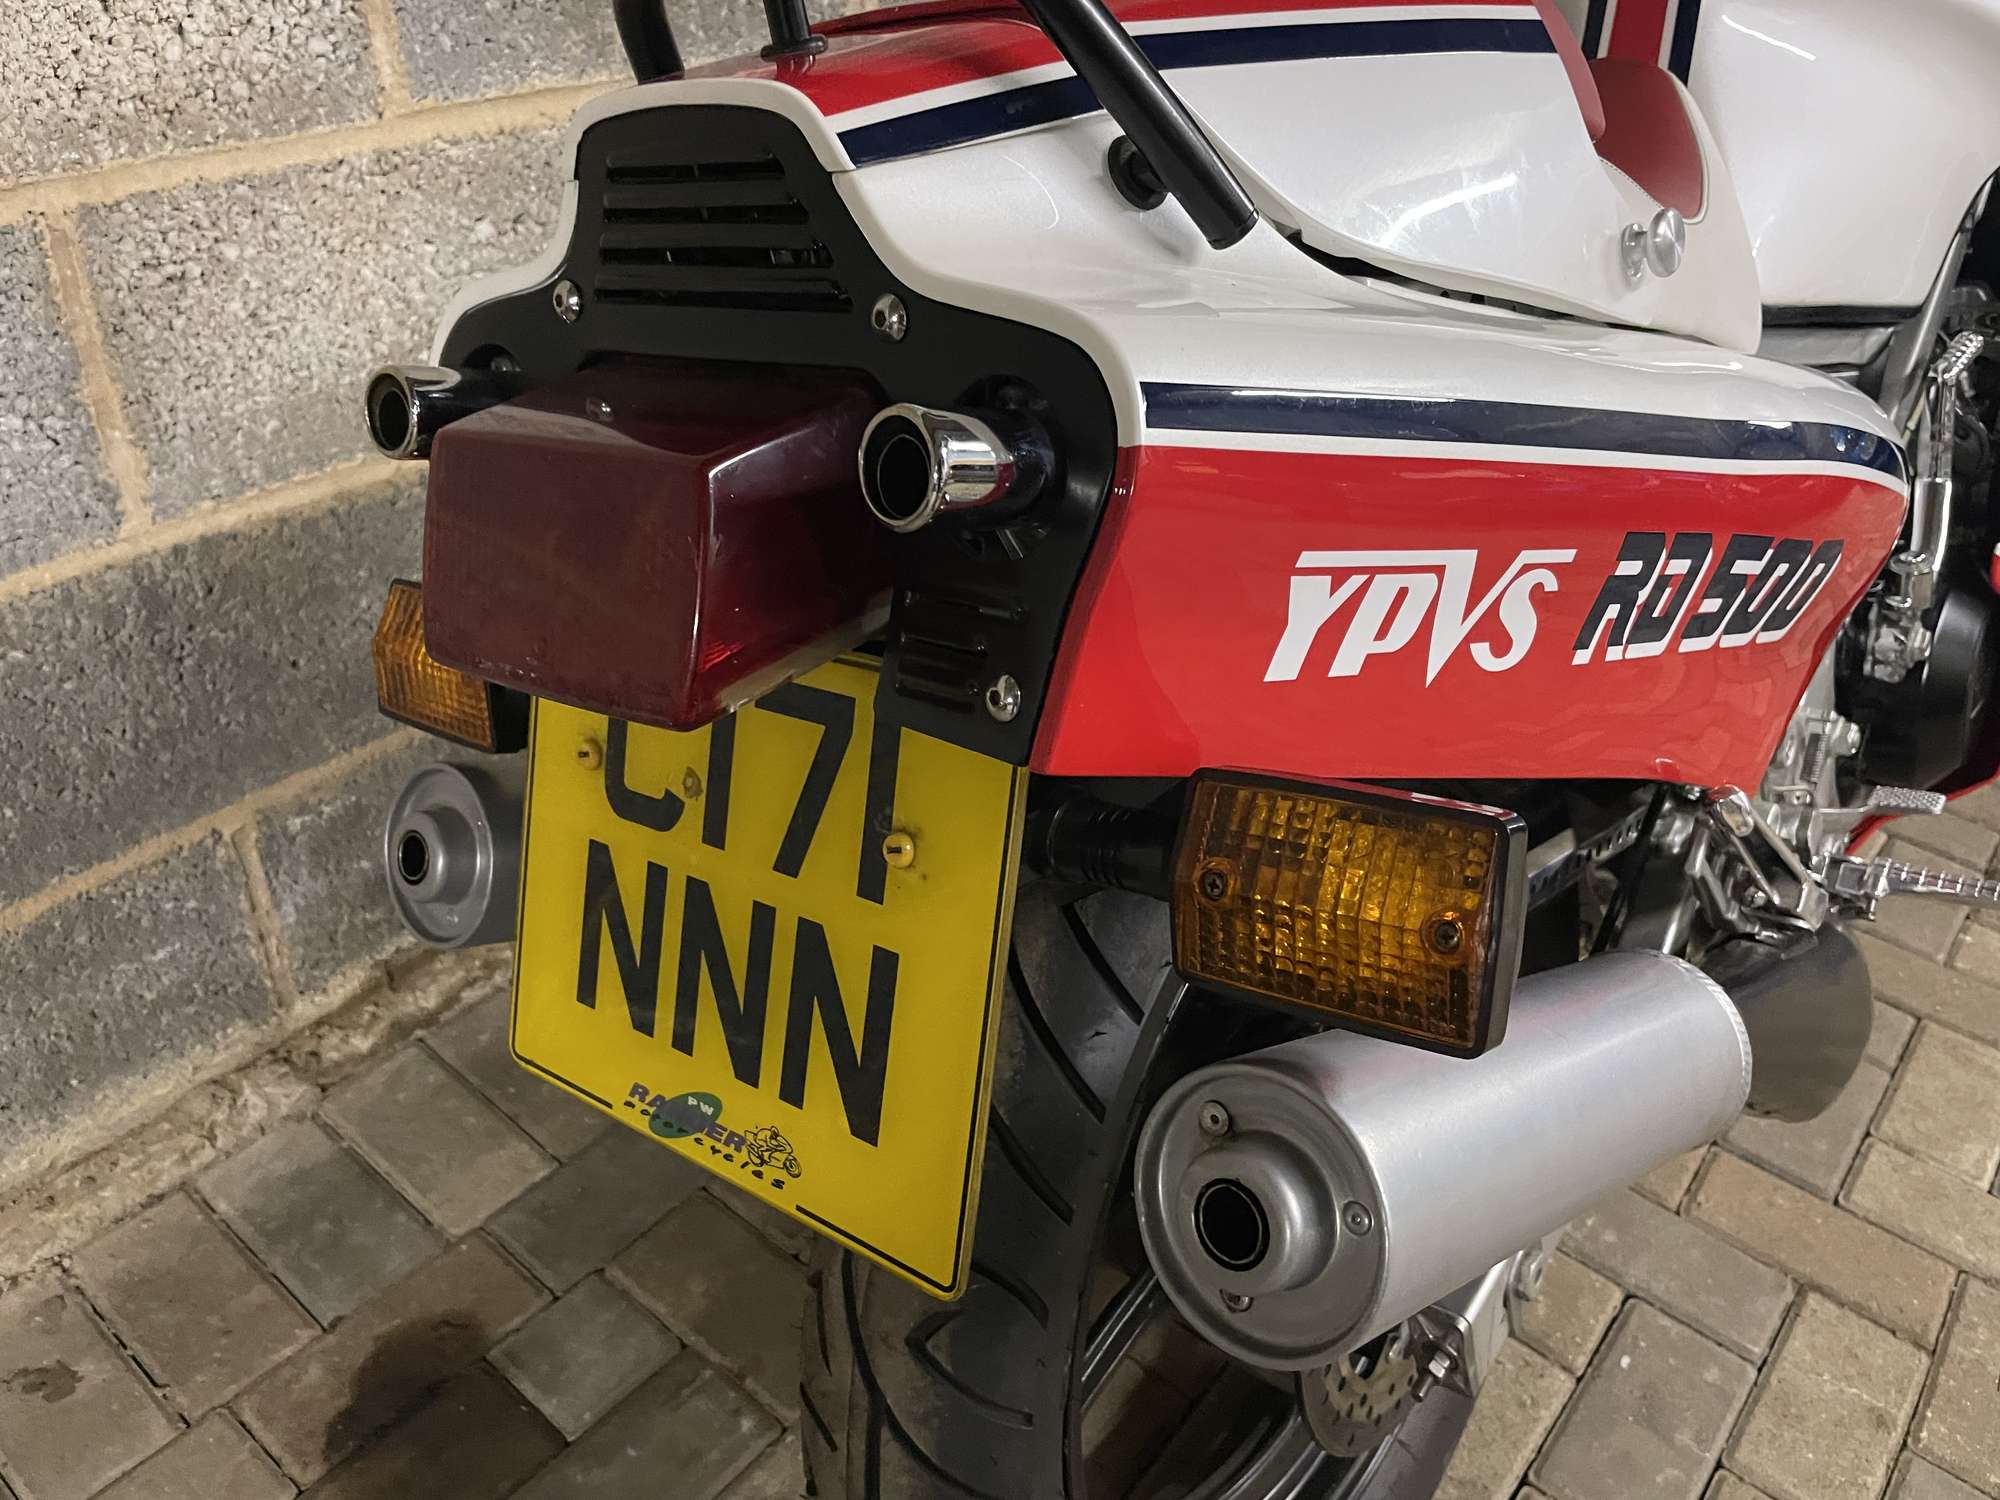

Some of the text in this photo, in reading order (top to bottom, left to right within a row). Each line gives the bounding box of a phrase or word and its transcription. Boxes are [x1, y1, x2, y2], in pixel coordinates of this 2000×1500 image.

[1263, 548, 1579, 688] YPVS
[604, 682, 901, 906] C171
[576, 838, 900, 1148] NNN
